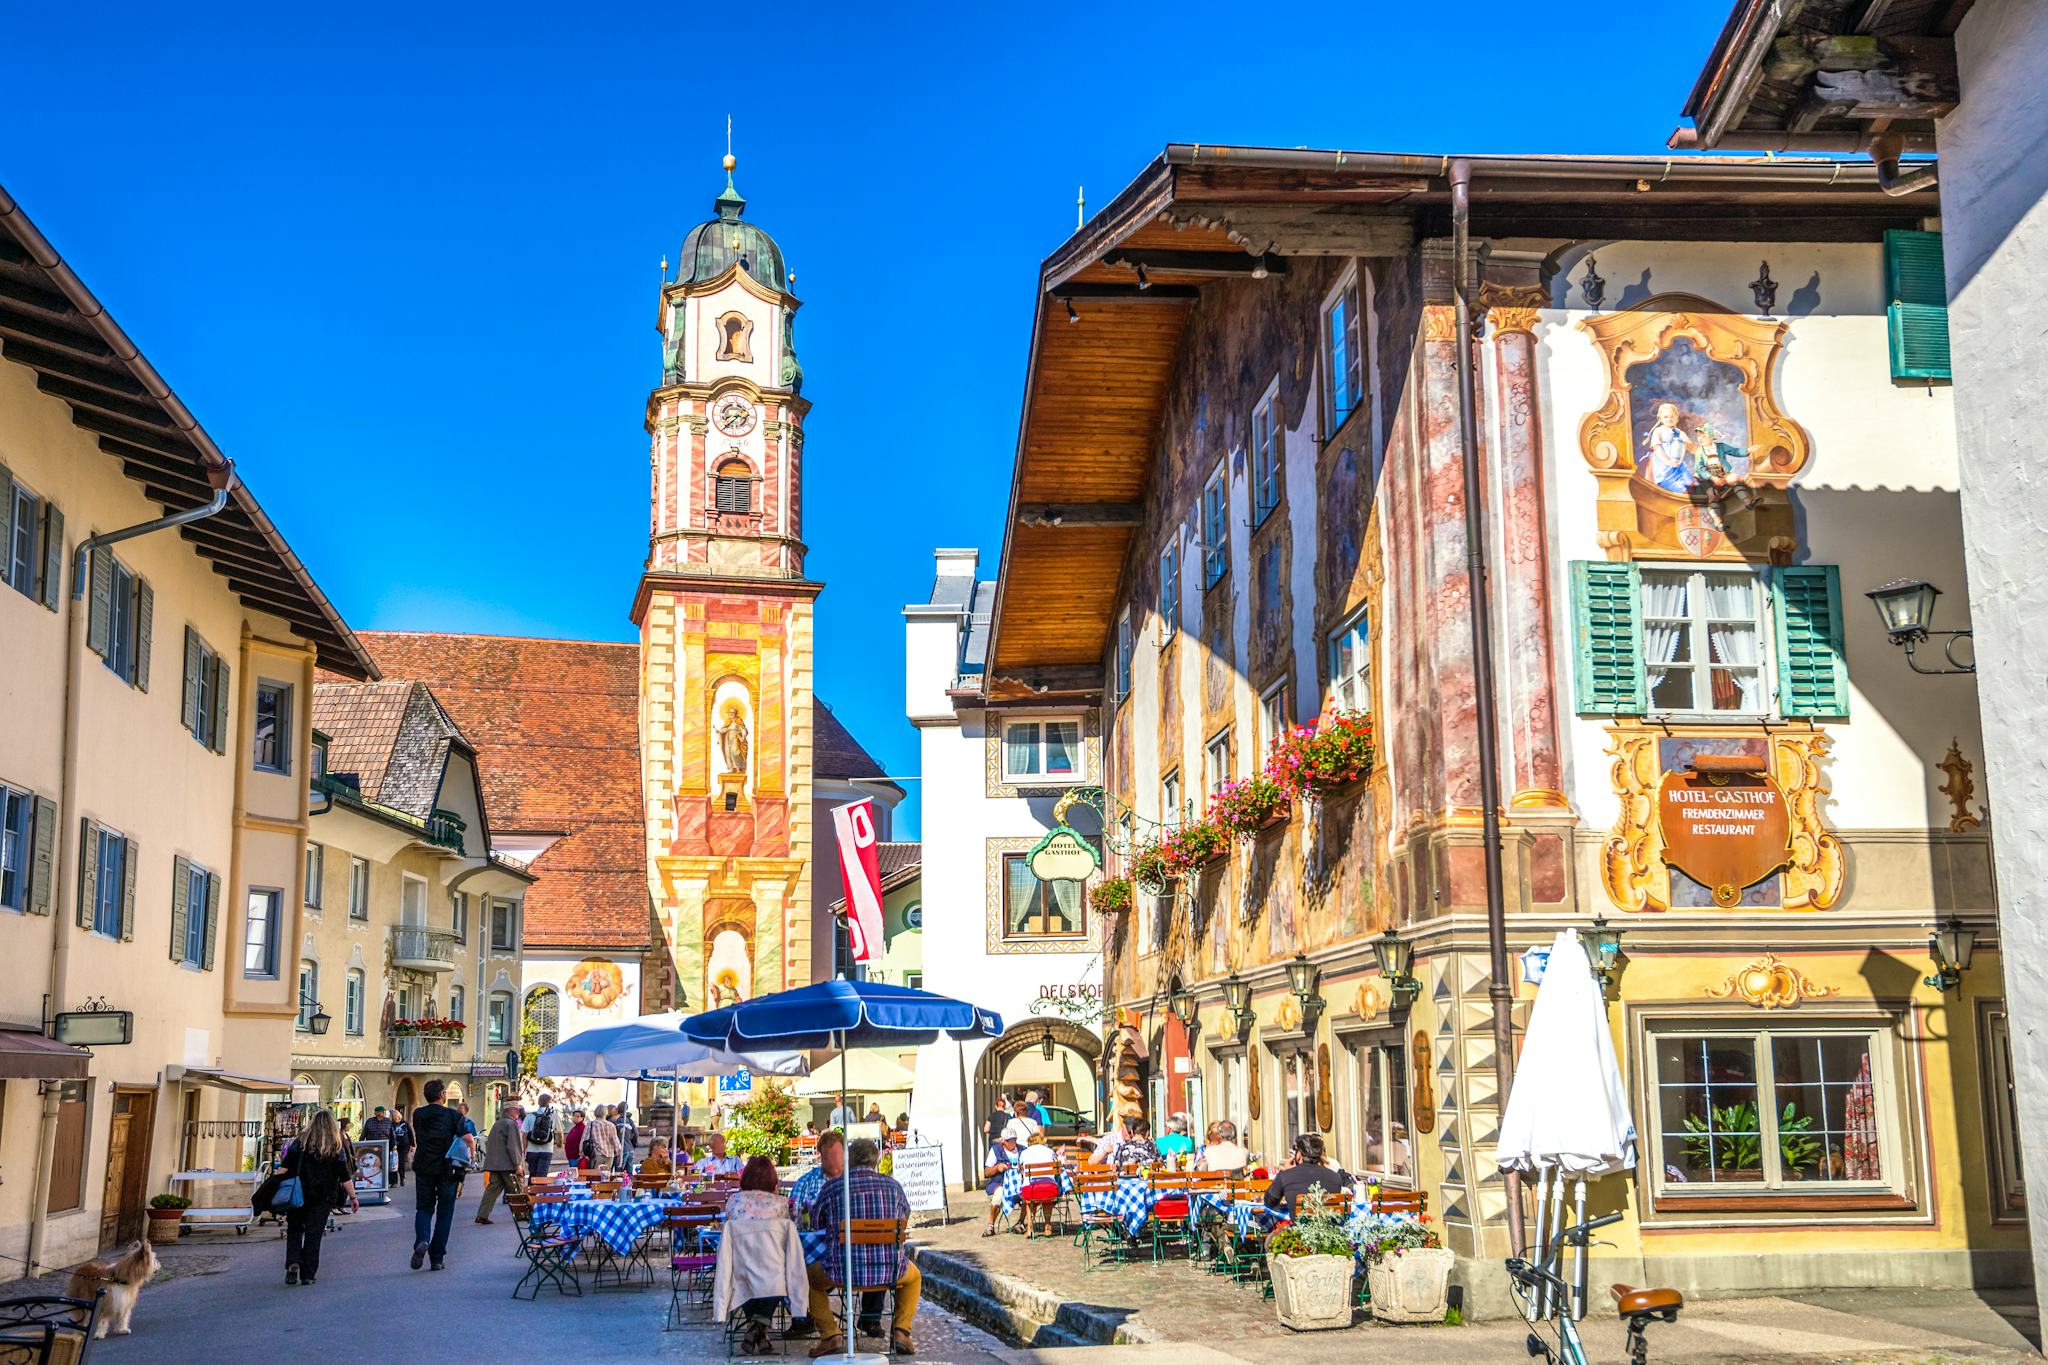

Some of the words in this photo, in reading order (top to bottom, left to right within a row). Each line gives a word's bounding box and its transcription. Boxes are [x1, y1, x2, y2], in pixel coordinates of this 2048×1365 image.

[1668, 790, 1776, 804] HOTEL-GASTHOF
[1682, 808, 1765, 820] FREMDENZIMMER
[1692, 824, 1756, 835] RESTAURANT
